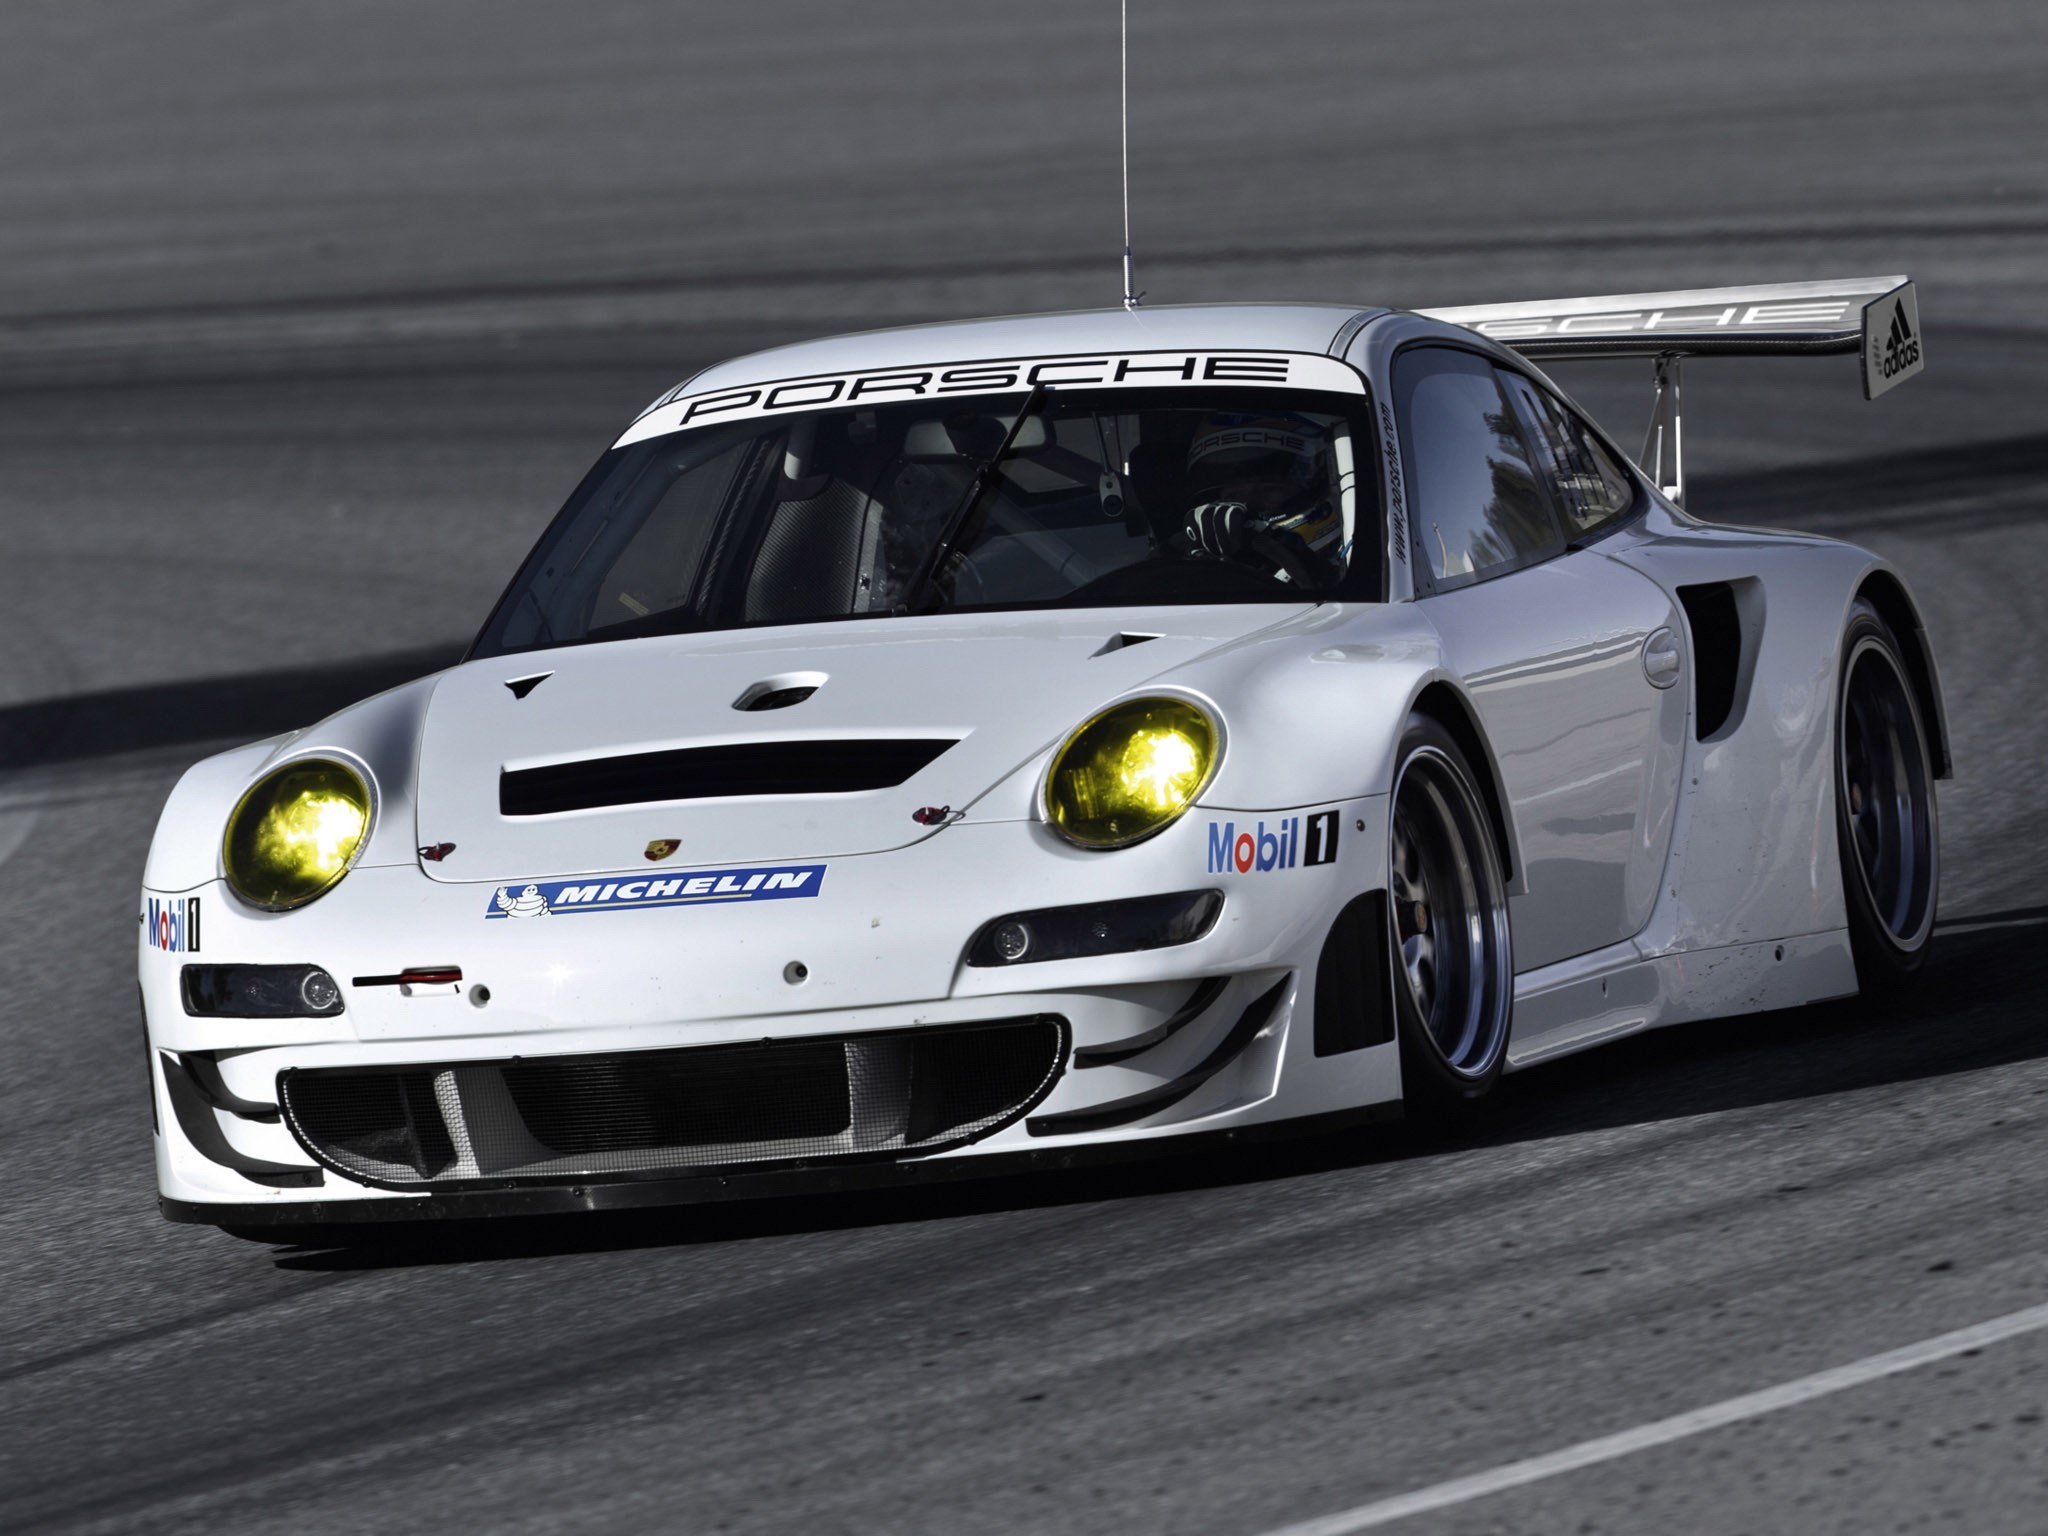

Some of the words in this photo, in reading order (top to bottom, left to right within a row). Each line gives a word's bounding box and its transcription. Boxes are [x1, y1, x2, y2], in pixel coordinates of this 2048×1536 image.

[1457, 301, 1851, 336] SCHE
[1883, 340, 1919, 379] adidas
[679, 357, 1290, 426] PORSCHE
[1189, 431, 1305, 459] ORSCHE
[1380, 401, 1407, 566] www.porsche.com
[1207, 817, 1298, 873] Mobil
[554, 872, 813, 905] MICHELIN
[148, 897, 185, 952] Mobil
